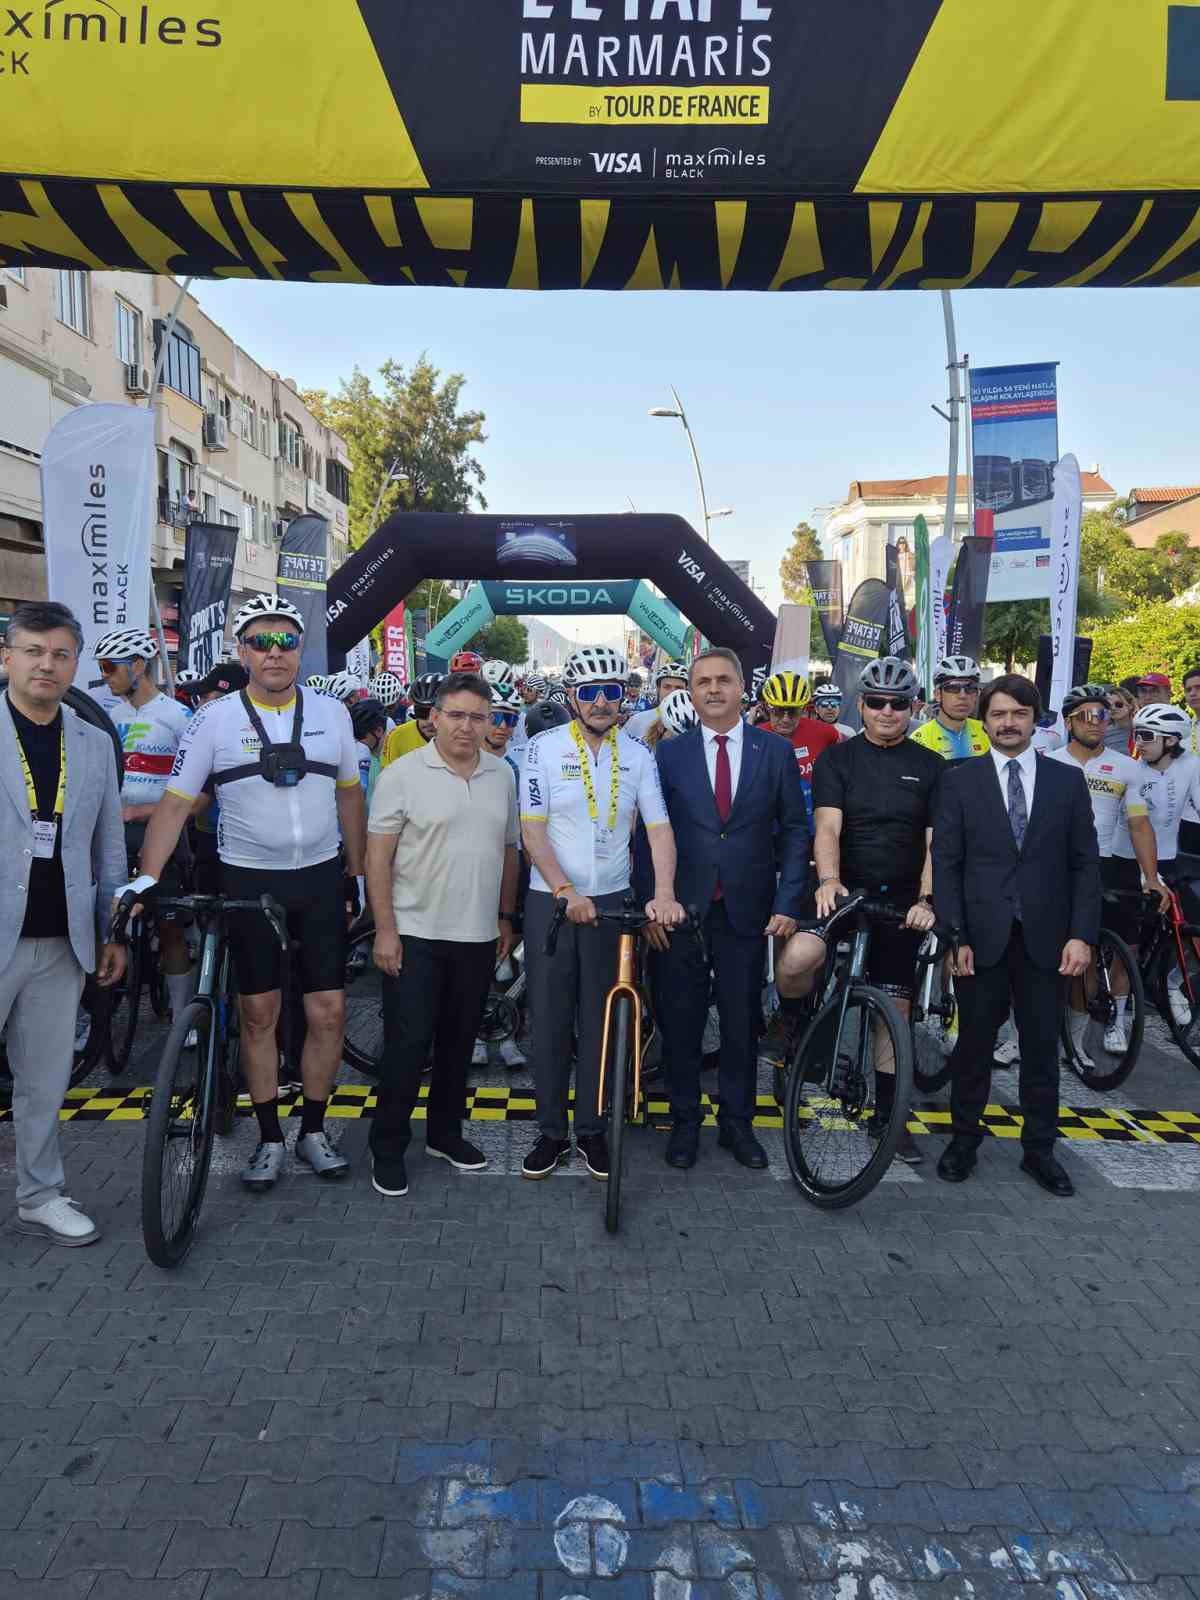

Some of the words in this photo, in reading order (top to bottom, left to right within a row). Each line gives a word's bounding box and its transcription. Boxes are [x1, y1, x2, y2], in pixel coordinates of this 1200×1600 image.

[520, 26, 773, 78] MARMARİS
[589, 106, 601, 118] BY
[604, 95, 655, 117] TOUR
[659, 95, 683, 117] DE
[688, 95, 761, 118] FRANCE
[535, 155, 573, 166] PRESENTED
[589, 152, 643, 173] VISA
[665, 147, 767, 166] maximiles
[665, 168, 704, 178] BLACK
[81, 463, 109, 624] maximiles
[351, 546, 394, 591] maximiles
[677, 549, 706, 583] VISA
[116, 563, 129, 624] BLACK
[326, 600, 348, 627] ISA
[712, 587, 755, 632] maximiles
[386, 626, 408, 688] UBER
[172, 748, 187, 777] VISA
[529, 779, 543, 808] VISA
